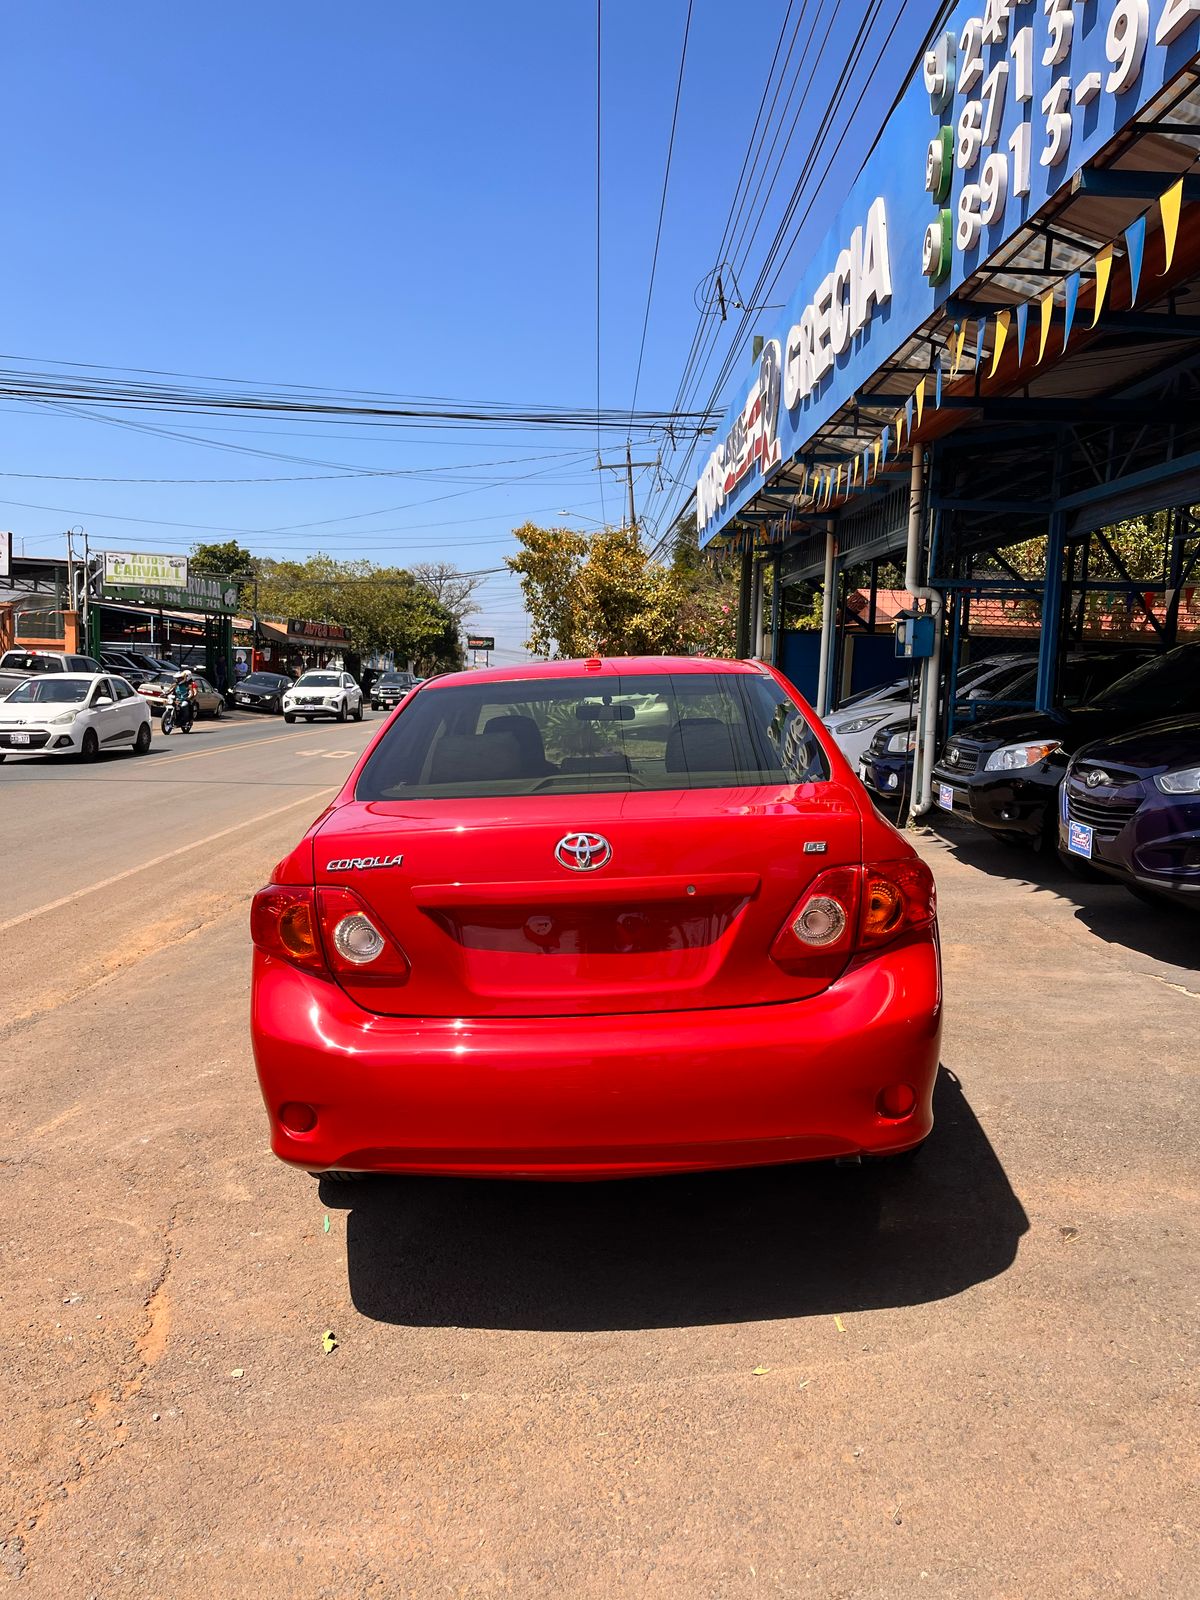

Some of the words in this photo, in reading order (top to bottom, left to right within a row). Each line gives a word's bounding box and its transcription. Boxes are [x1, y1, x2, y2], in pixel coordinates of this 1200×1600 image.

[784, 196, 893, 411] GRECIA
[131, 555, 165, 566] AUTOS
[113, 564, 182, 579] CARVAJAL
[326, 854, 404, 871] COROLLA
